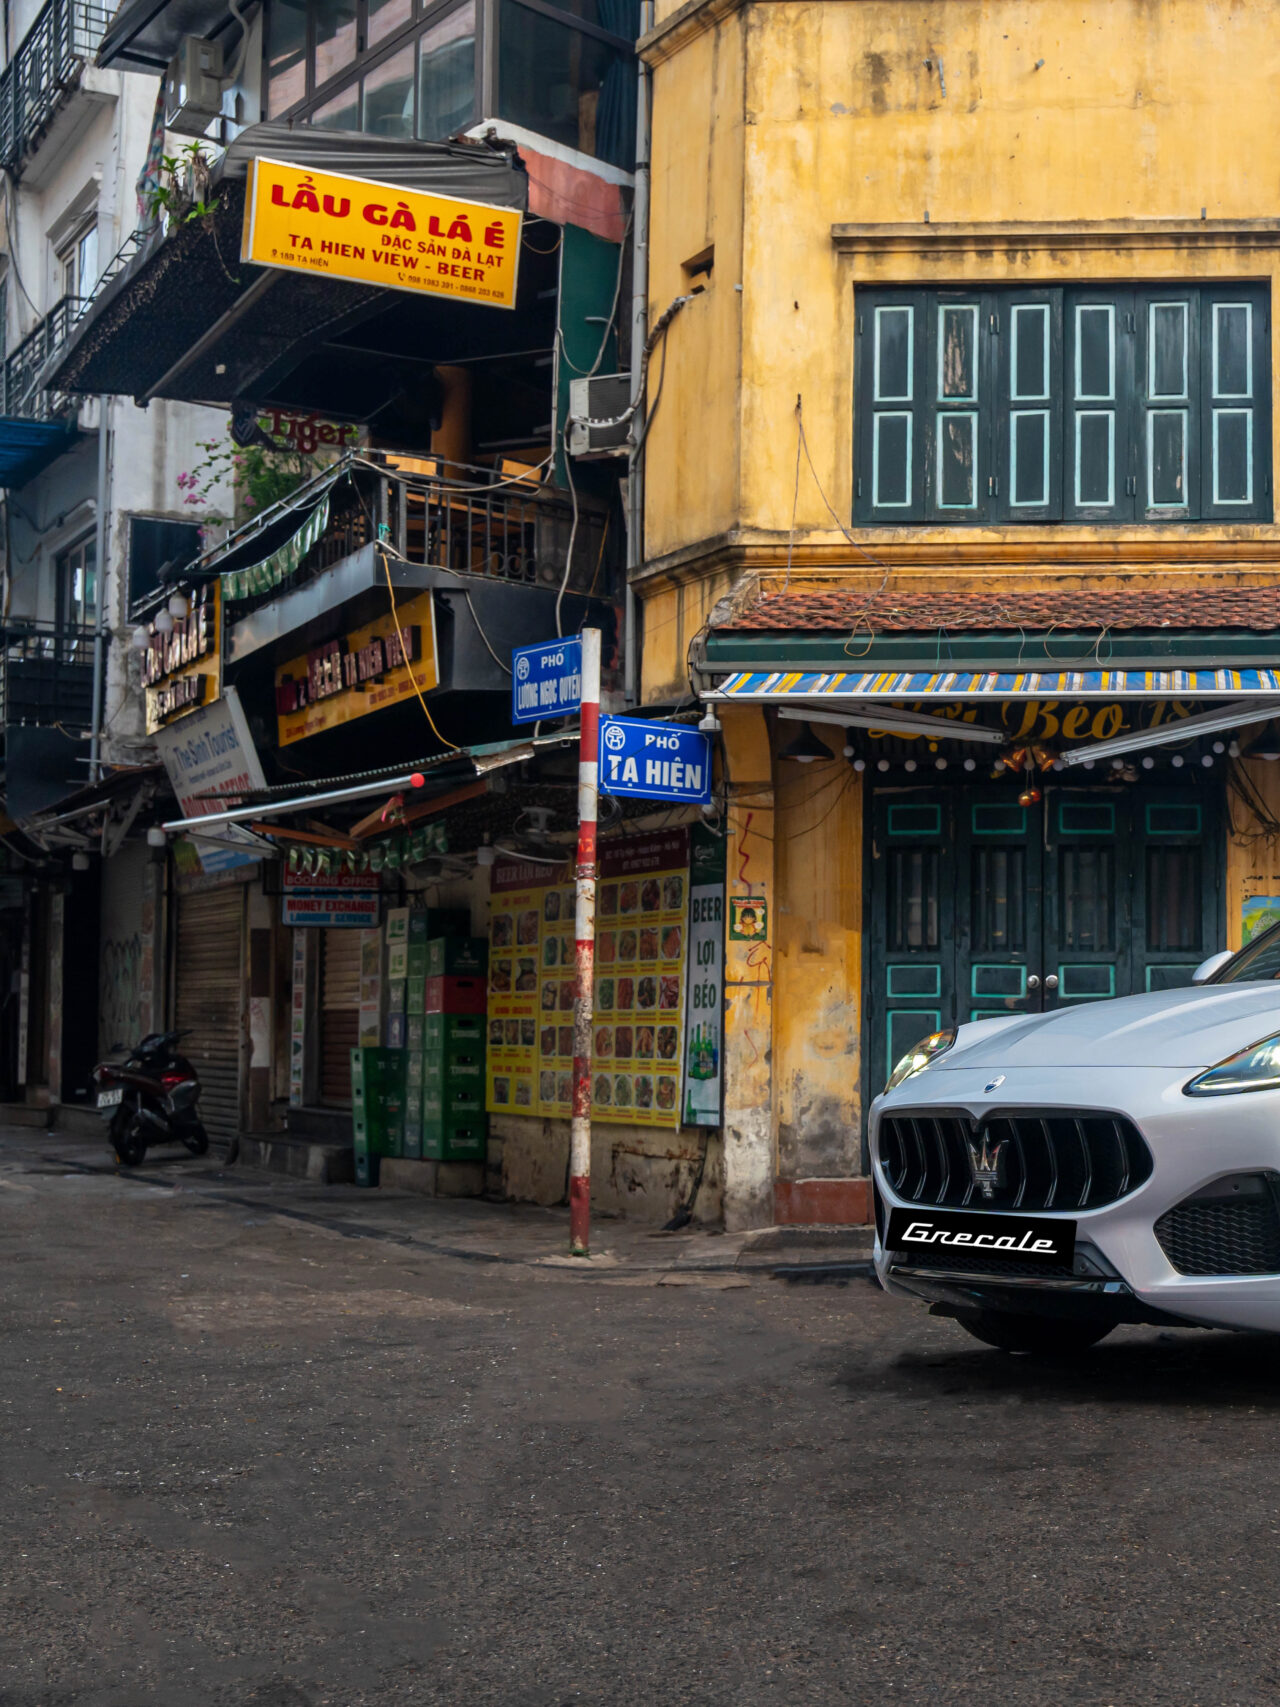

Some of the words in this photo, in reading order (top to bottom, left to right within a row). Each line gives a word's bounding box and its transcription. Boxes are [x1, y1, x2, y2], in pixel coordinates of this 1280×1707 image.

[271, 175, 350, 218] LẨU
[362, 201, 416, 232] GÀ
[428, 214, 472, 243] LÁ
[484, 221, 505, 249] É
[288, 234, 313, 250] TA
[321, 240, 365, 260] HIEN
[372, 250, 419, 270] VIEW
[438, 262, 485, 282] BEER
[381, 234, 412, 251] ĐẶC
[417, 238, 447, 257] SẢN
[451, 246, 471, 262] ĐÀ
[477, 252, 504, 269] LẠT
[266, 407, 353, 454] Tiger
[541, 646, 565, 669] PHỐ
[204, 722, 239, 757] Tourist
[645, 732, 682, 750] PHỐ
[608, 754, 639, 787] TẠ
[646, 756, 702, 792] HIỆN
[287, 900, 322, 912] MONEY
[325, 900, 376, 913] EXCHANGE
[692, 896, 722, 923] BEER
[697, 938, 715, 972] LỢI
[693, 980, 717, 1009] BÉO
[901, 1222, 1058, 1254] Grecale
